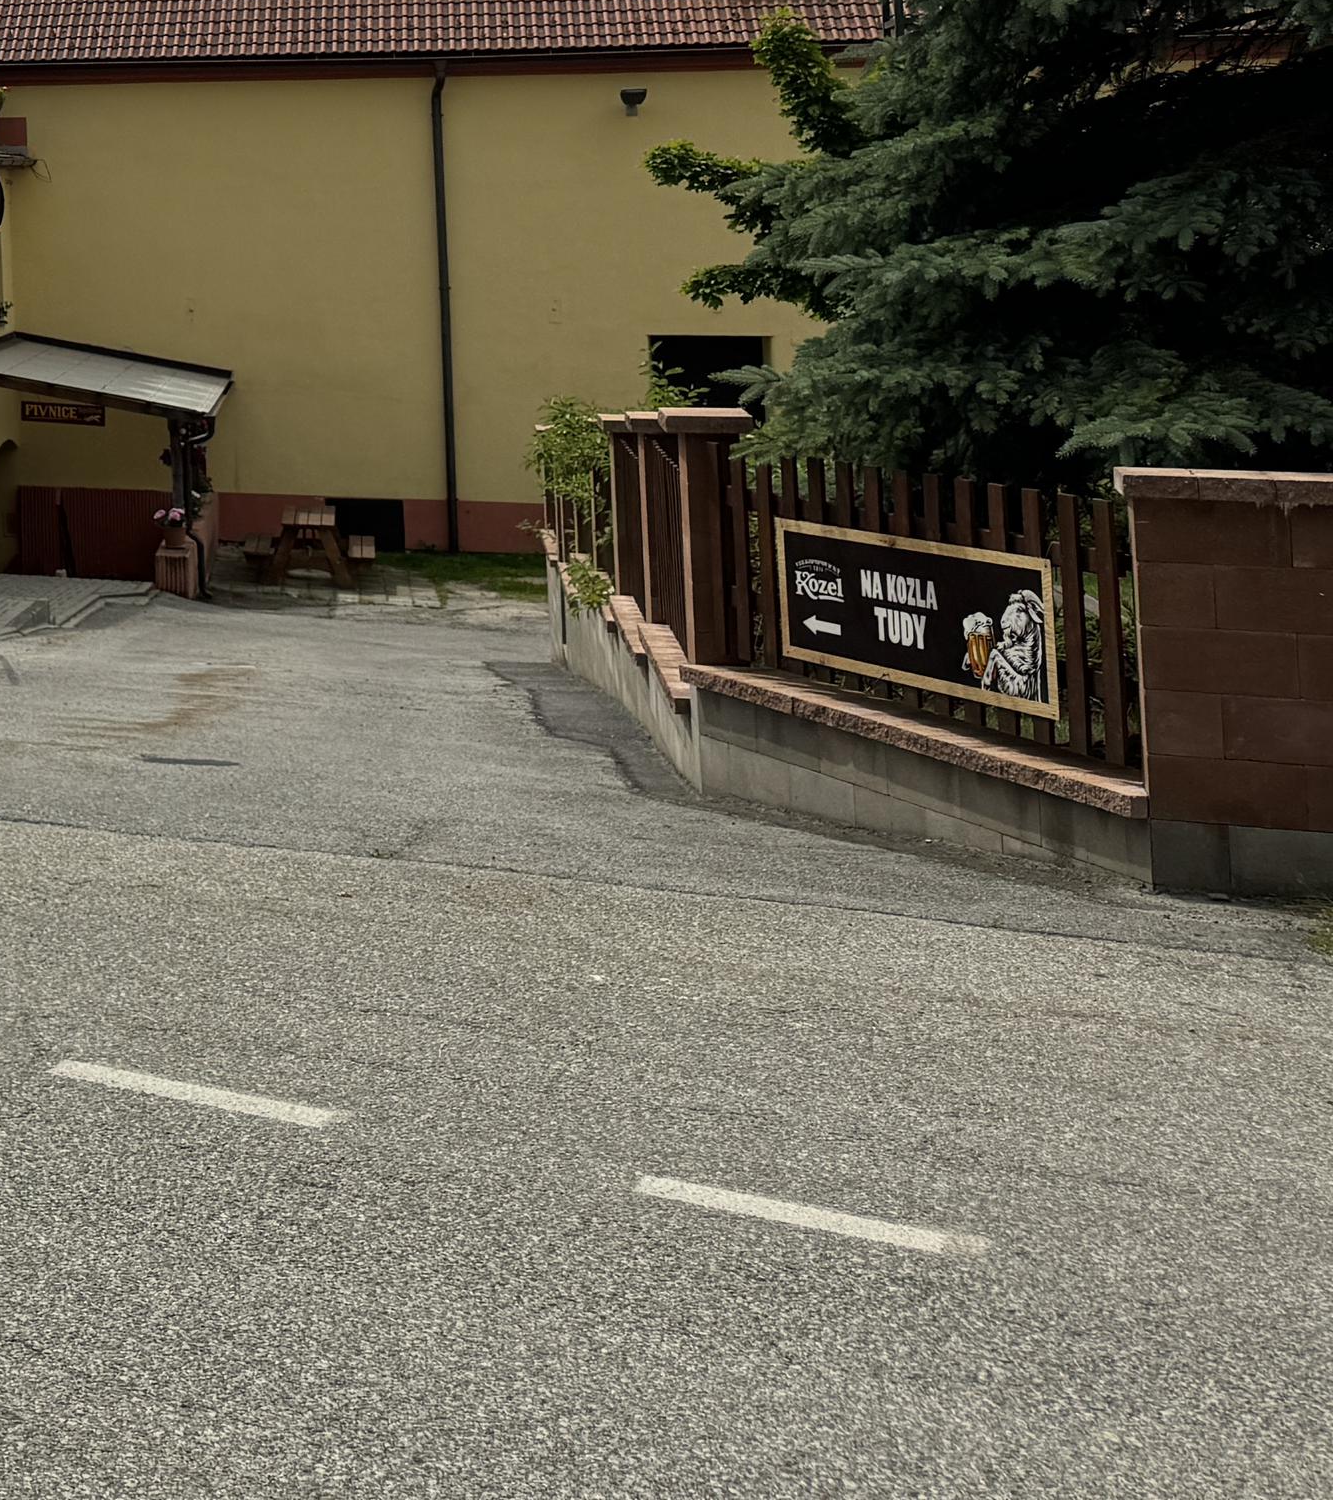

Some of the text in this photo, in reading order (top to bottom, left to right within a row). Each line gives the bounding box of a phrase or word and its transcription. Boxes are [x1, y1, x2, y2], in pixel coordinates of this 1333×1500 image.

[25, 403, 78, 419] PIVNICE
[794, 570, 845, 603] Kozel
[859, 568, 939, 611] NA KOZLA
[874, 606, 927, 650] TUDY
